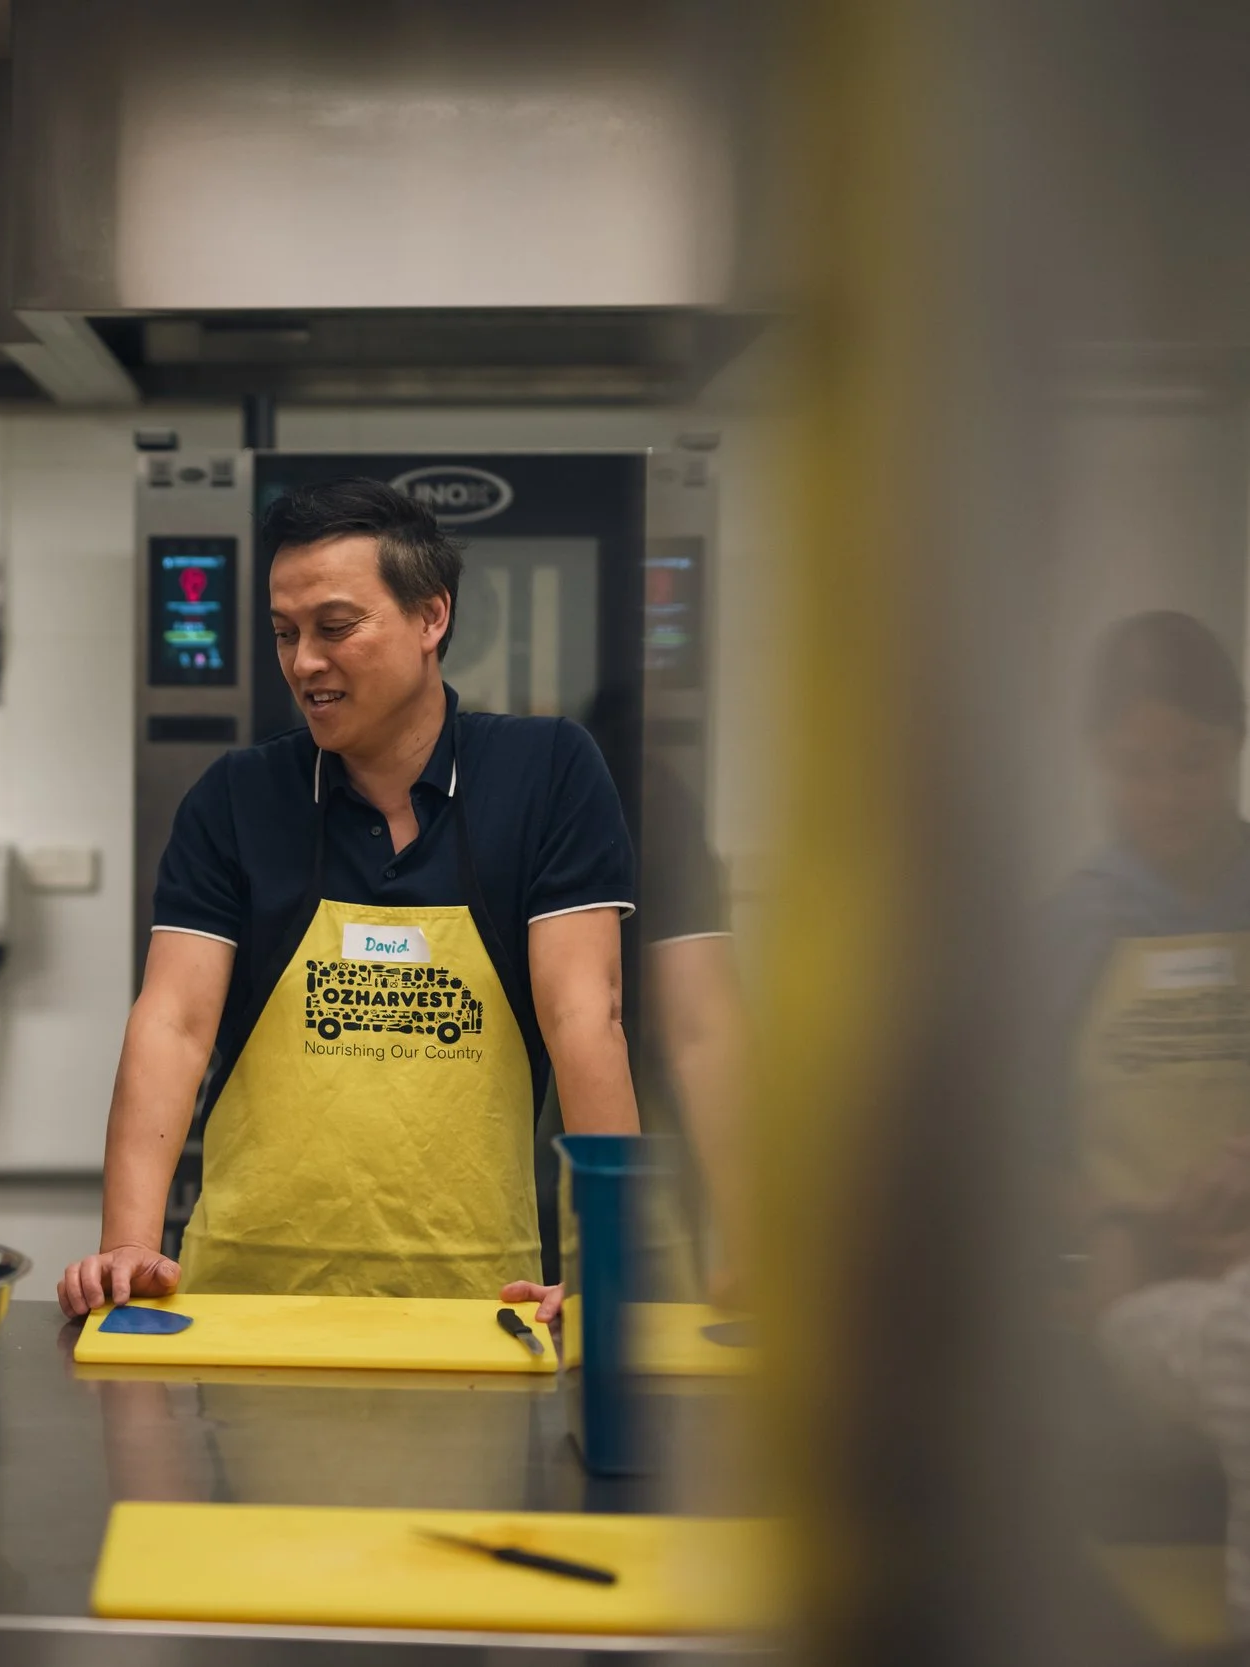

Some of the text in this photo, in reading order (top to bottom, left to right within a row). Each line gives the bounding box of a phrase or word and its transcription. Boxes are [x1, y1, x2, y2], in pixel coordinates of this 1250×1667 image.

[322, 987, 456, 1008] OZHARVEST
[304, 1040, 483, 1063] Nourishing Our Country
